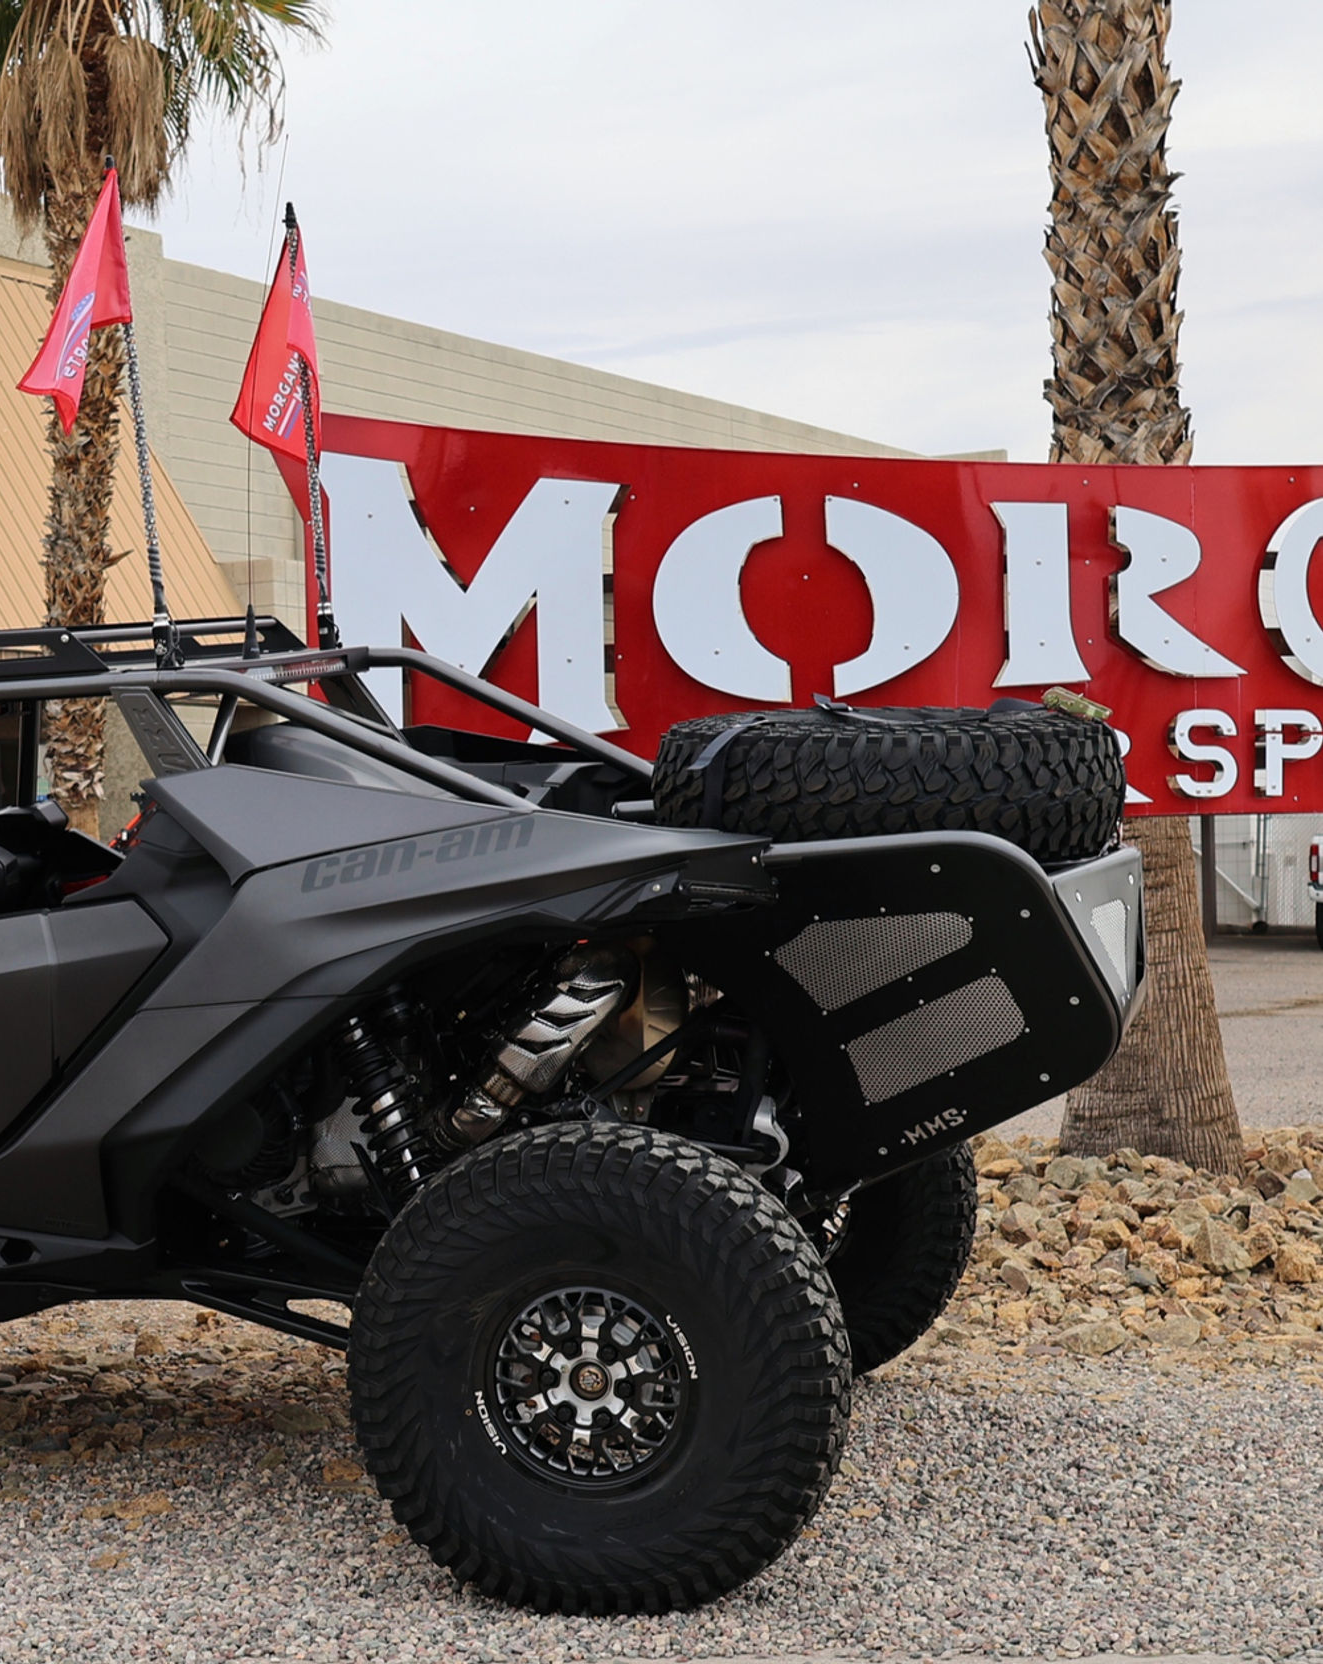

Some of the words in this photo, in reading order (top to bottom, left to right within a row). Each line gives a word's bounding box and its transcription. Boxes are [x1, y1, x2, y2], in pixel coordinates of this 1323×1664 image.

[262, 352, 301, 433] MORGAN
[301, 815, 535, 893] can-am
[665, 1314, 698, 1380] VISION
[474, 1390, 508, 1455] VISION
